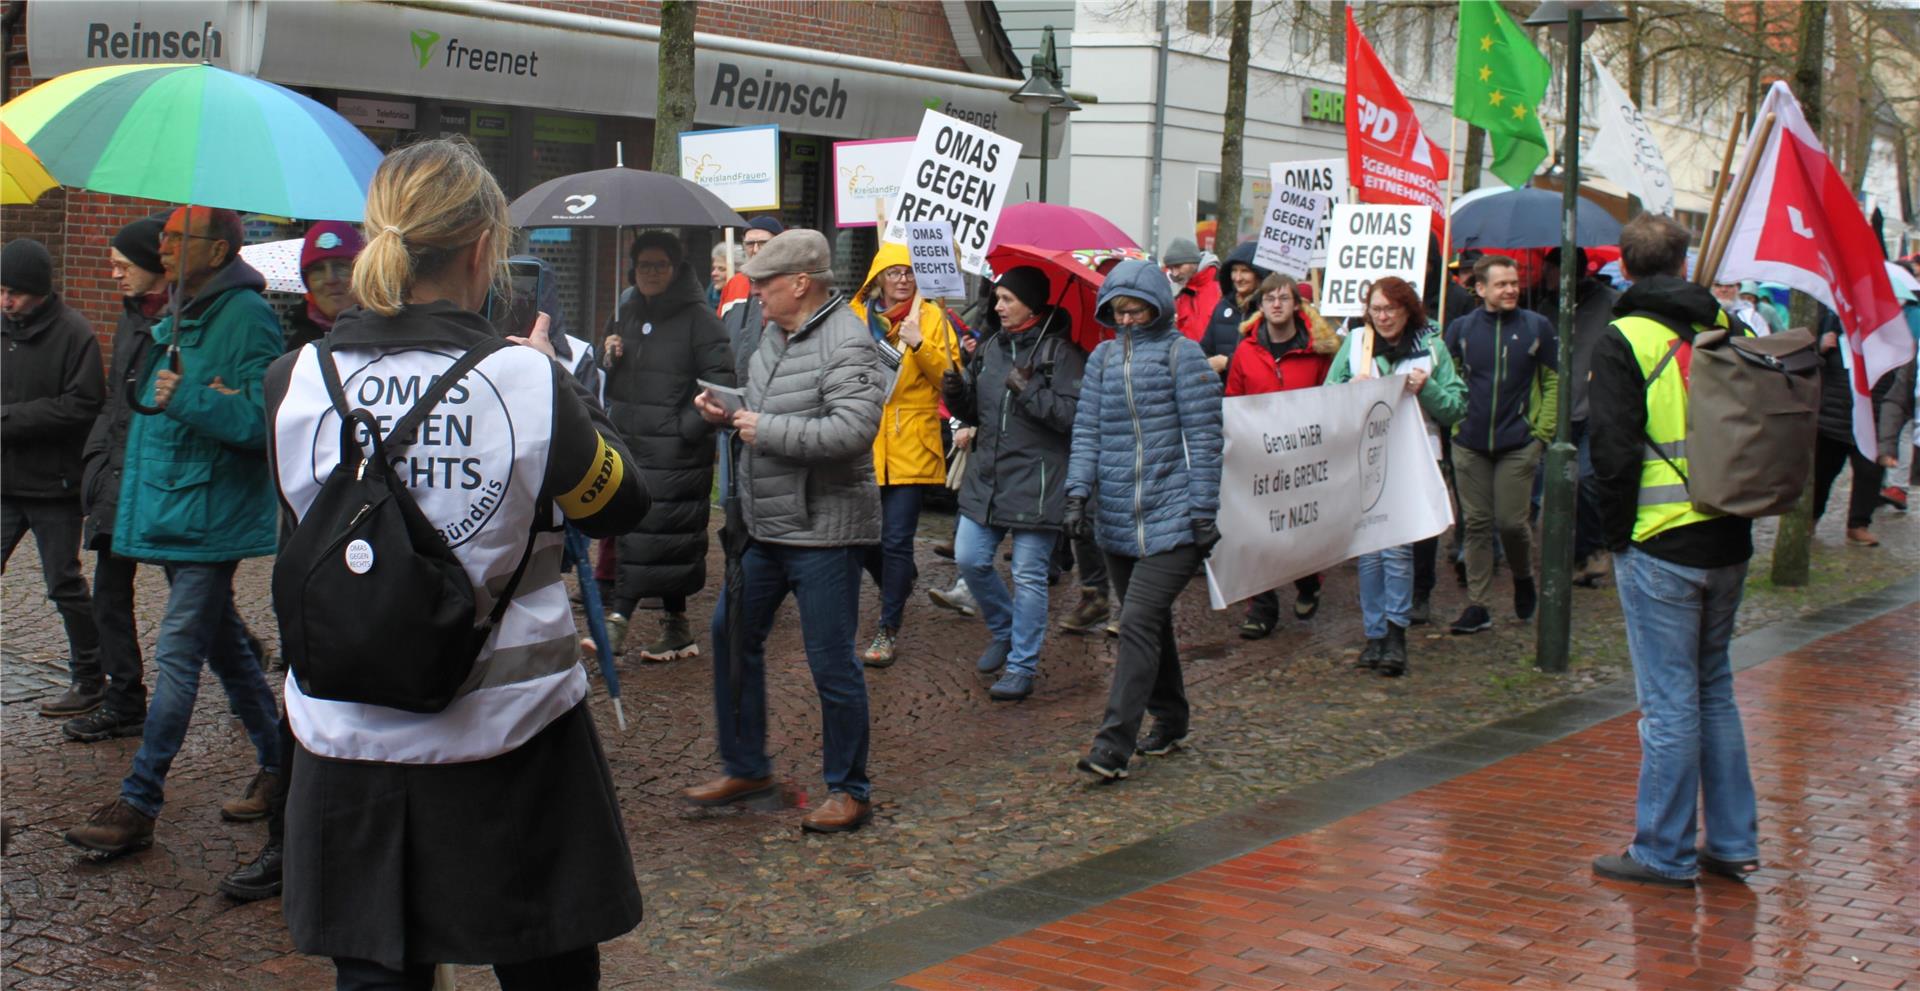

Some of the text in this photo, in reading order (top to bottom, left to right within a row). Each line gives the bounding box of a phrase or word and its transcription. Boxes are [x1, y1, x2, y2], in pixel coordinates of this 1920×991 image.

[87, 21, 222, 58] Reinsch
[446, 38, 539, 77] freenet
[710, 62, 848, 120] Reinsch
[1310, 89, 1345, 123] BAR
[945, 102, 998, 130] freenet
[1356, 94, 1398, 143] SPD
[935, 126, 1000, 173] OMAS
[917, 159, 996, 212] GEGEN
[1285, 168, 1333, 191] OMAS
[1281, 190, 1316, 211] OMAS
[896, 193, 989, 250] RECHTS
[912, 228, 943, 240] OMAS
[1272, 209, 1315, 231] GEGEN
[1350, 212, 1412, 236] OMAS
[913, 245, 949, 257] GEGEN
[1264, 226, 1313, 250] RECHTS
[914, 262, 956, 274] RECHTS
[1339, 245, 1415, 270] GEGEN
[355, 414, 473, 447] EEN
[1263, 424, 1323, 455] Genau HIER
[389, 456, 482, 490] CHTS
[1253, 459, 1329, 497] ist die GRENZE
[437, 479, 502, 544] Bündnis
[1269, 500, 1319, 533] für NAZIS
[350, 552, 369, 560] GEGEN
